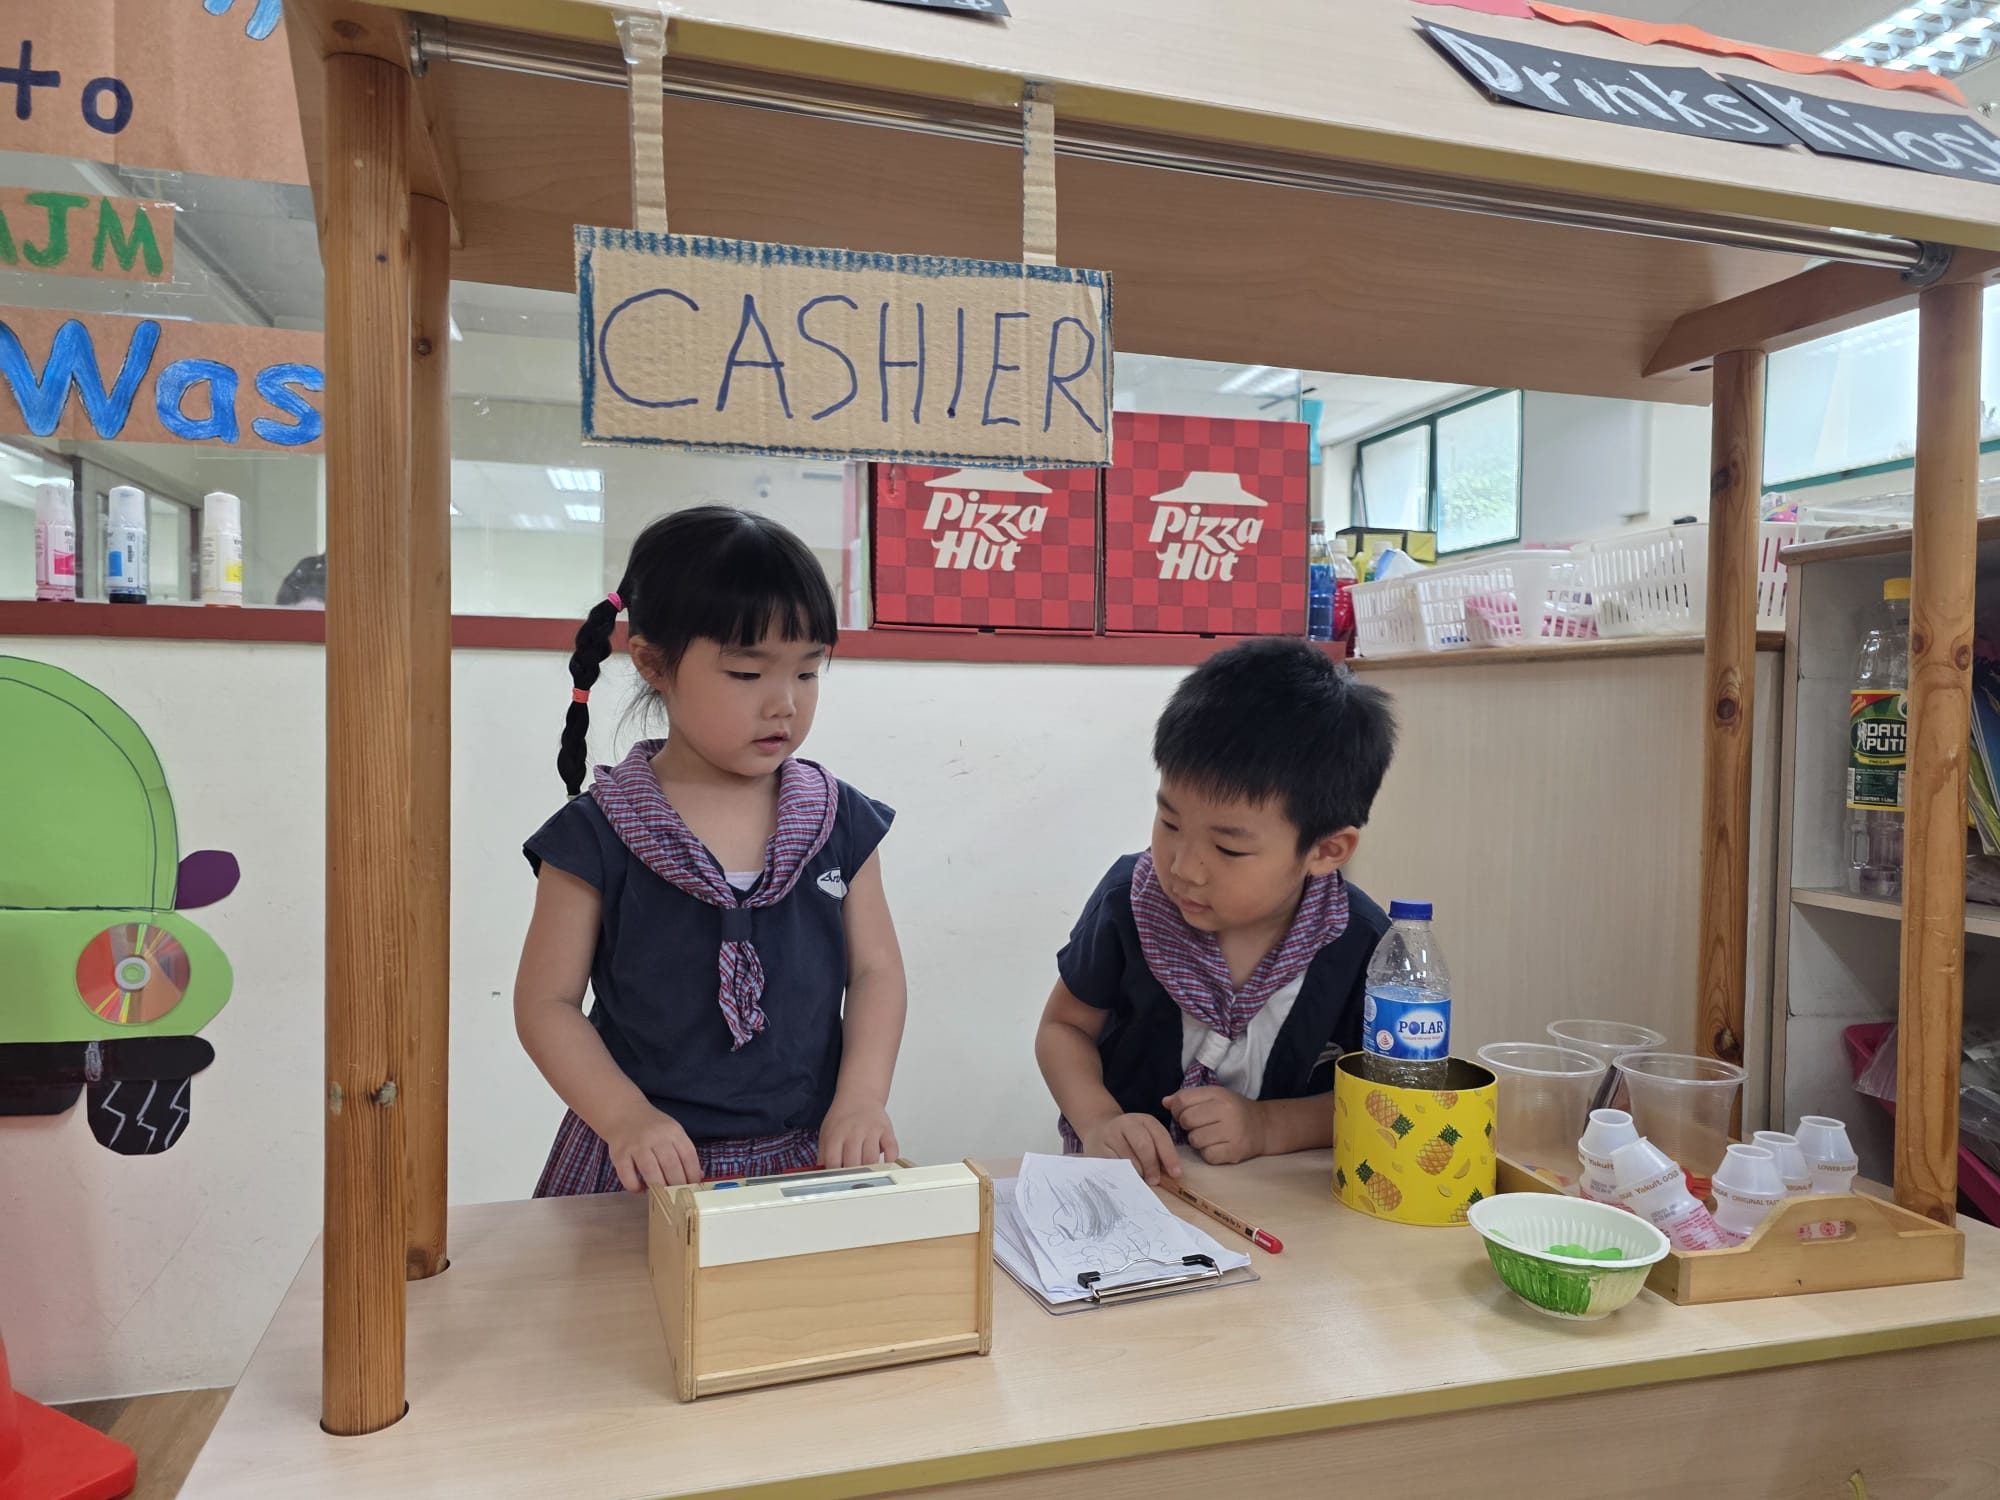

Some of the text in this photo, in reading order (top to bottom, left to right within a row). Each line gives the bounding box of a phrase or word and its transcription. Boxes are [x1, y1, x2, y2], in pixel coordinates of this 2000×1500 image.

[1428, 25, 1770, 134] Drinks
[599, 288, 1103, 434] CASHIER
[923, 491, 1048, 543] Pizza
[1148, 504, 1264, 554] Pizza
[932, 530, 1022, 572] Hut
[1155, 542, 1239, 581] Hut
[1398, 1020, 1444, 1035] POLAR
[1588, 1159, 1614, 1170] Yakult
[1634, 1179, 1663, 1195] Yakult
